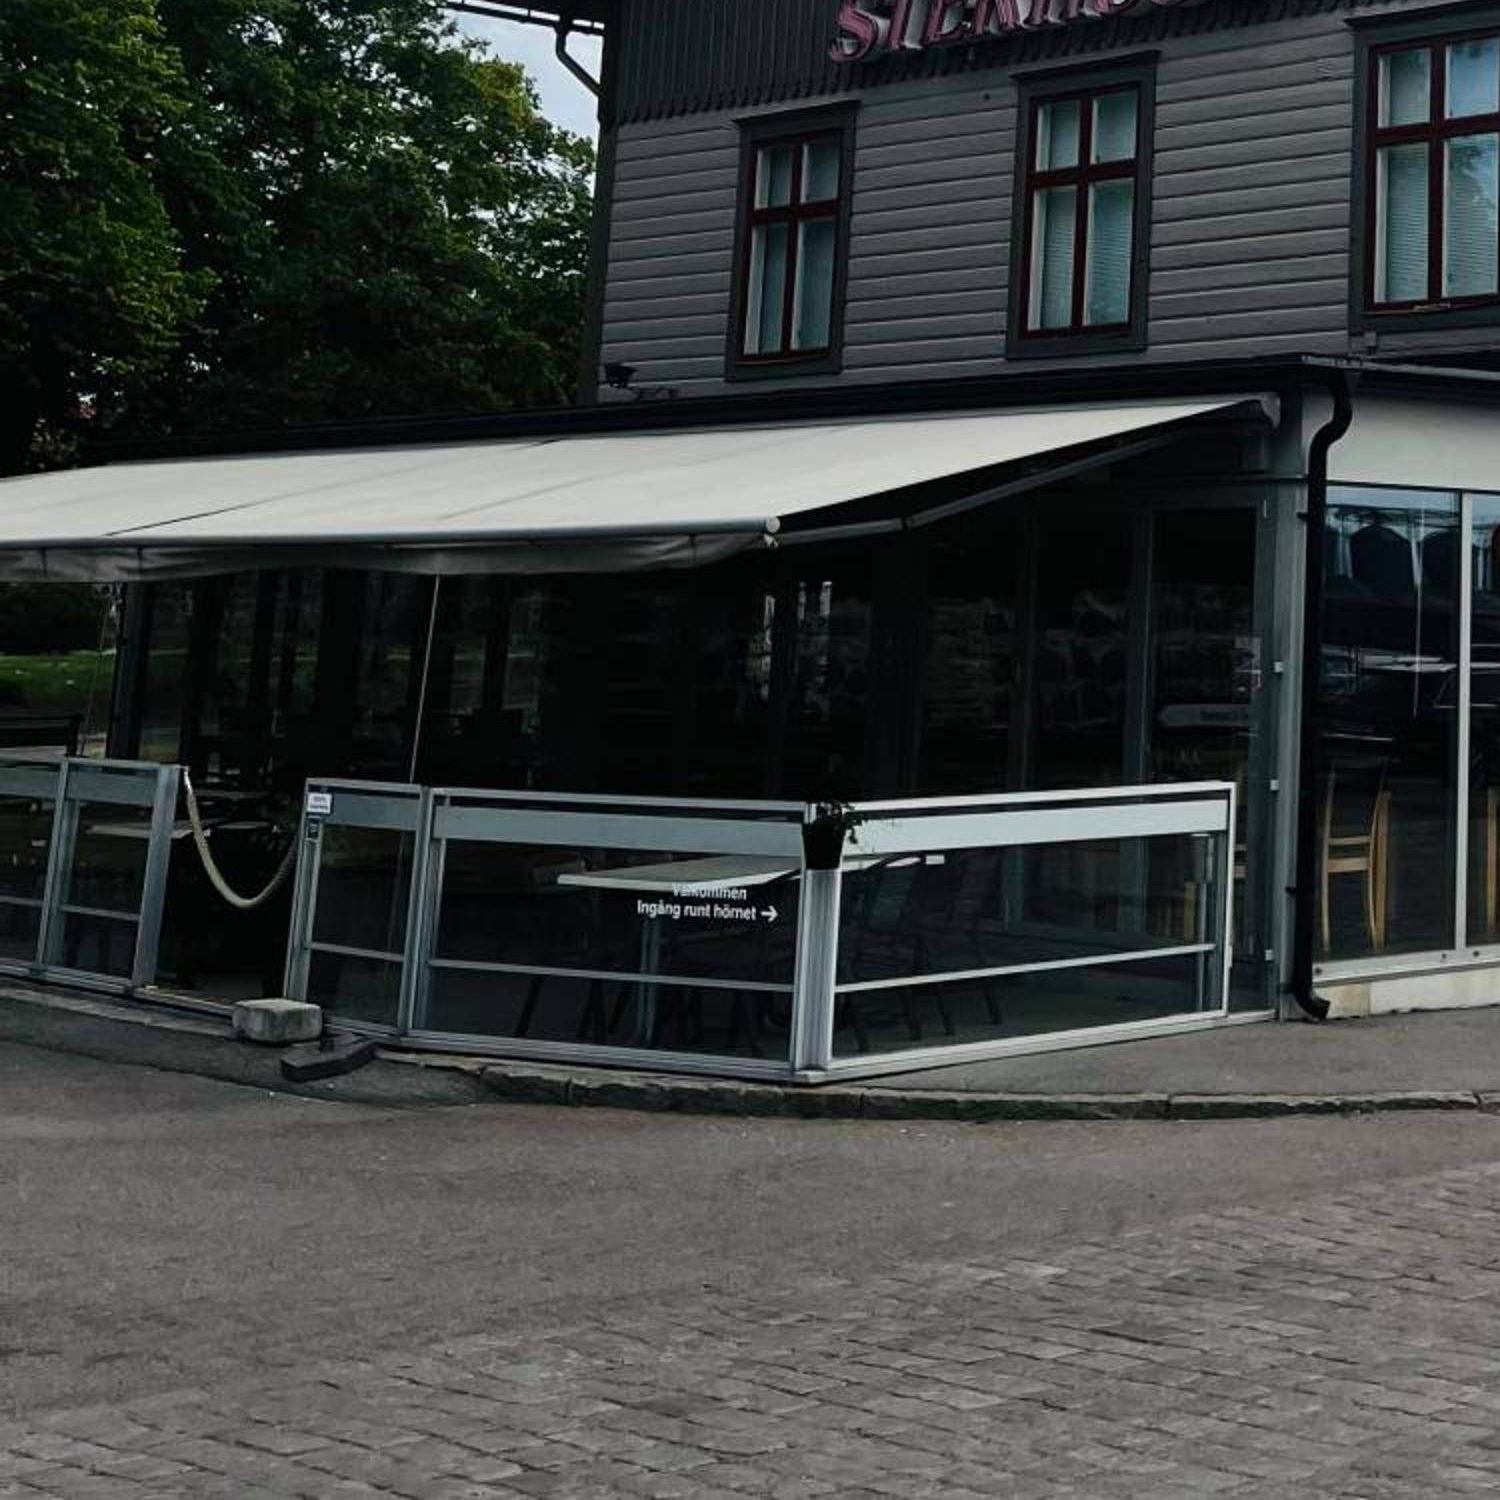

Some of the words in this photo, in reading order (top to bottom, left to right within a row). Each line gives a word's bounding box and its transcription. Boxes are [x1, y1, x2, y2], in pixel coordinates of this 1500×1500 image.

[637, 900, 681, 919] Ingång
[683, 904, 710, 917] runt
[714, 903, 757, 920] hörnet
